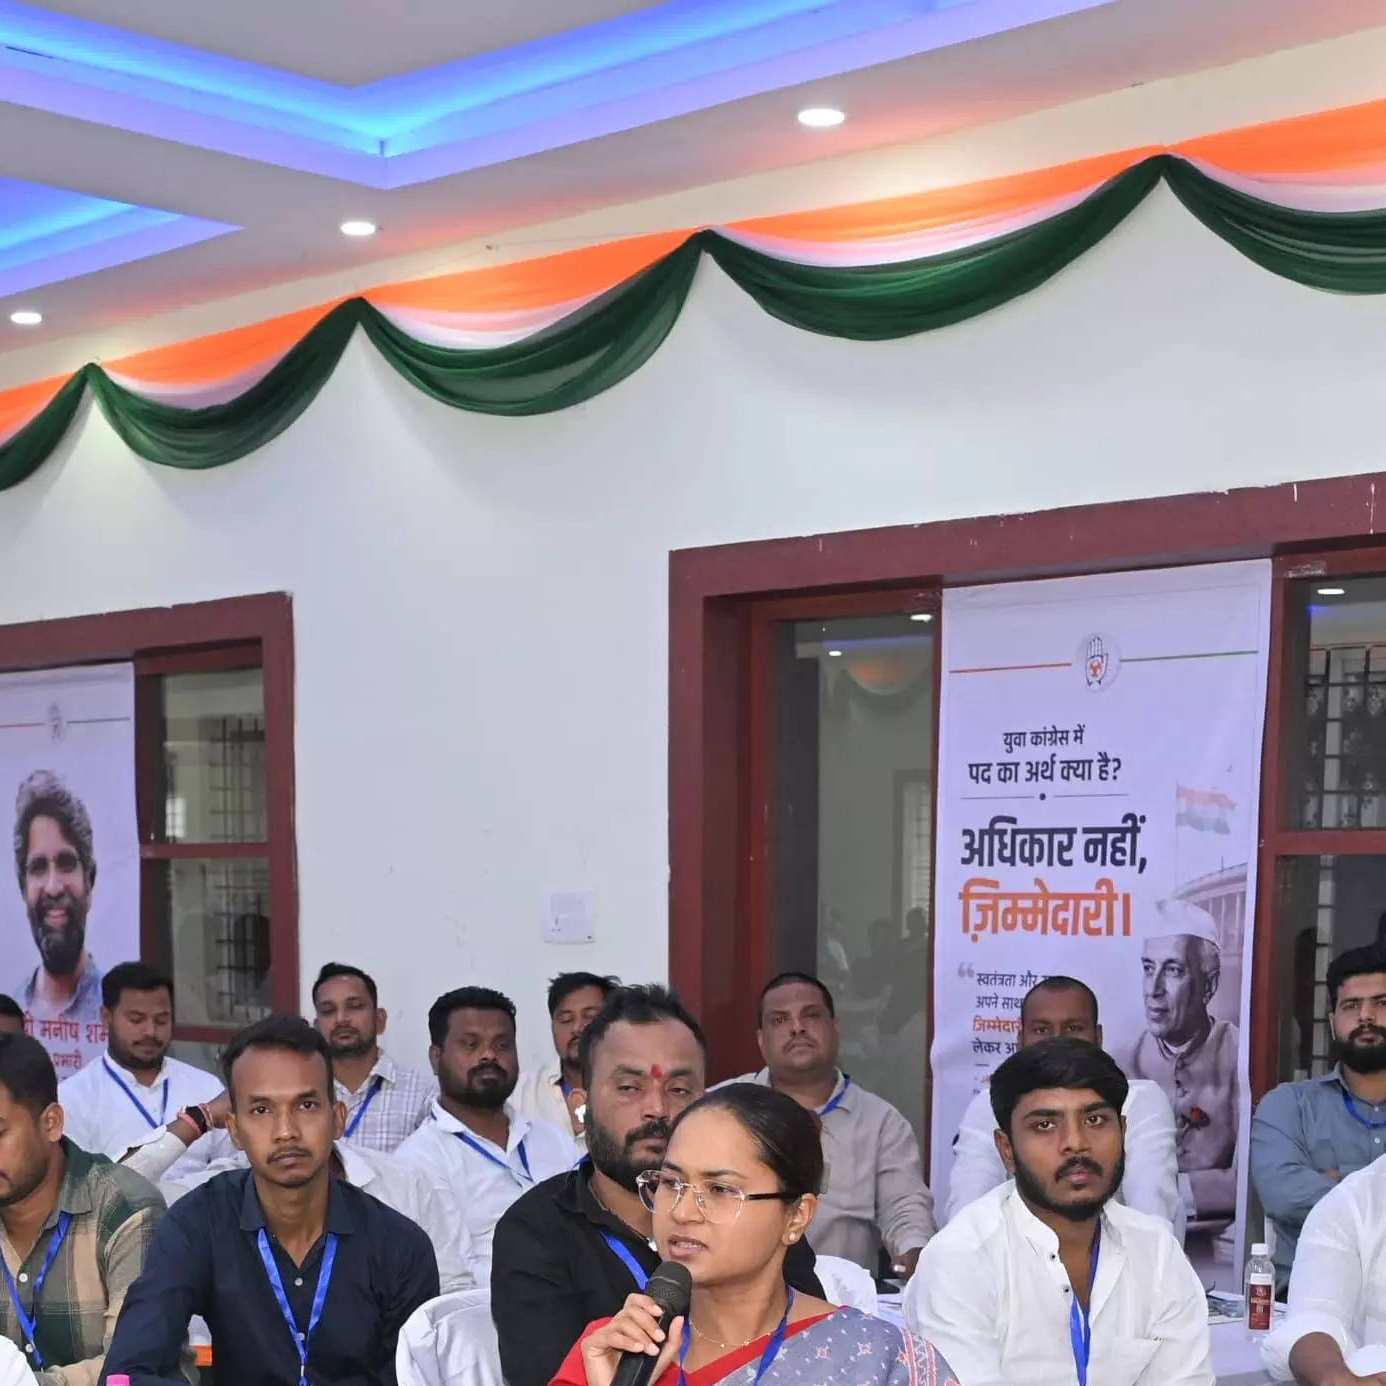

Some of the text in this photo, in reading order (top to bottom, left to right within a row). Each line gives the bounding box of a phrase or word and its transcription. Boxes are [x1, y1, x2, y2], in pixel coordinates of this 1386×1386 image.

[1003, 724, 1085, 753] युवा कांग्रेस में
[968, 752, 1122, 784] पद का अर्थ क्या है?
[961, 813, 1147, 874] अधिकार नहीं,
[976, 970, 1038, 988] स्वतंत्रता और
[975, 992, 998, 1009] अपने
[39, 1013, 79, 1042] मनीष
[972, 1037, 1001, 1055] लेकर
